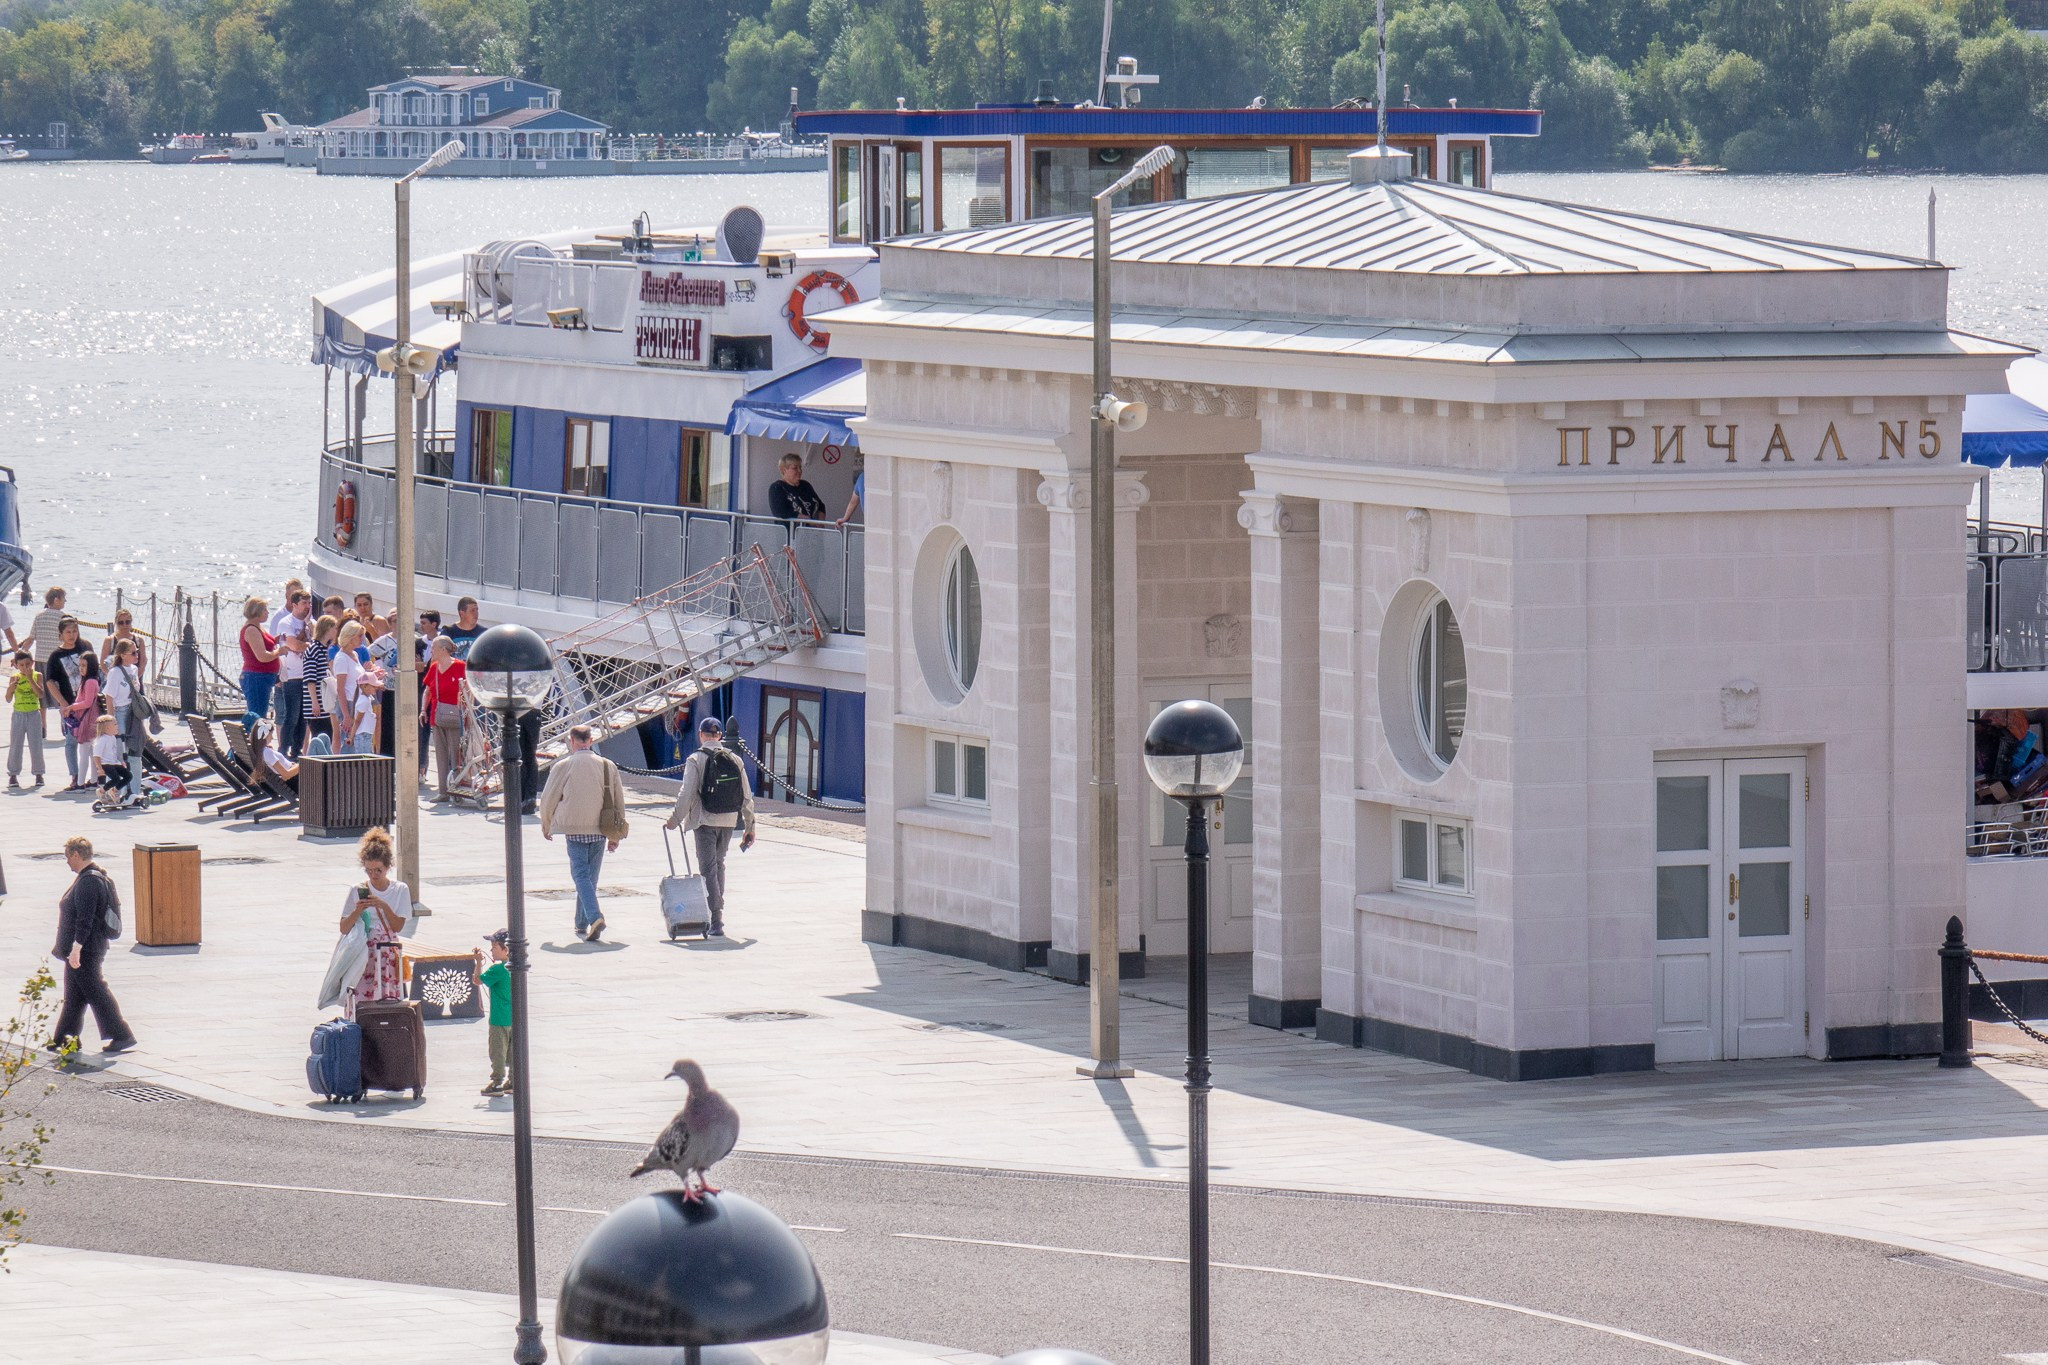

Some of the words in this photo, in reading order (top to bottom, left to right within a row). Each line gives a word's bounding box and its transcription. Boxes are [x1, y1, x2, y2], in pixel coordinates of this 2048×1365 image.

[639, 271, 667, 303] Анна
[668, 272, 720, 306] Каренина
[634, 316, 695, 360] РЕСТОРАН
[1557, 420, 1848, 466] ПРИЧАЛ
